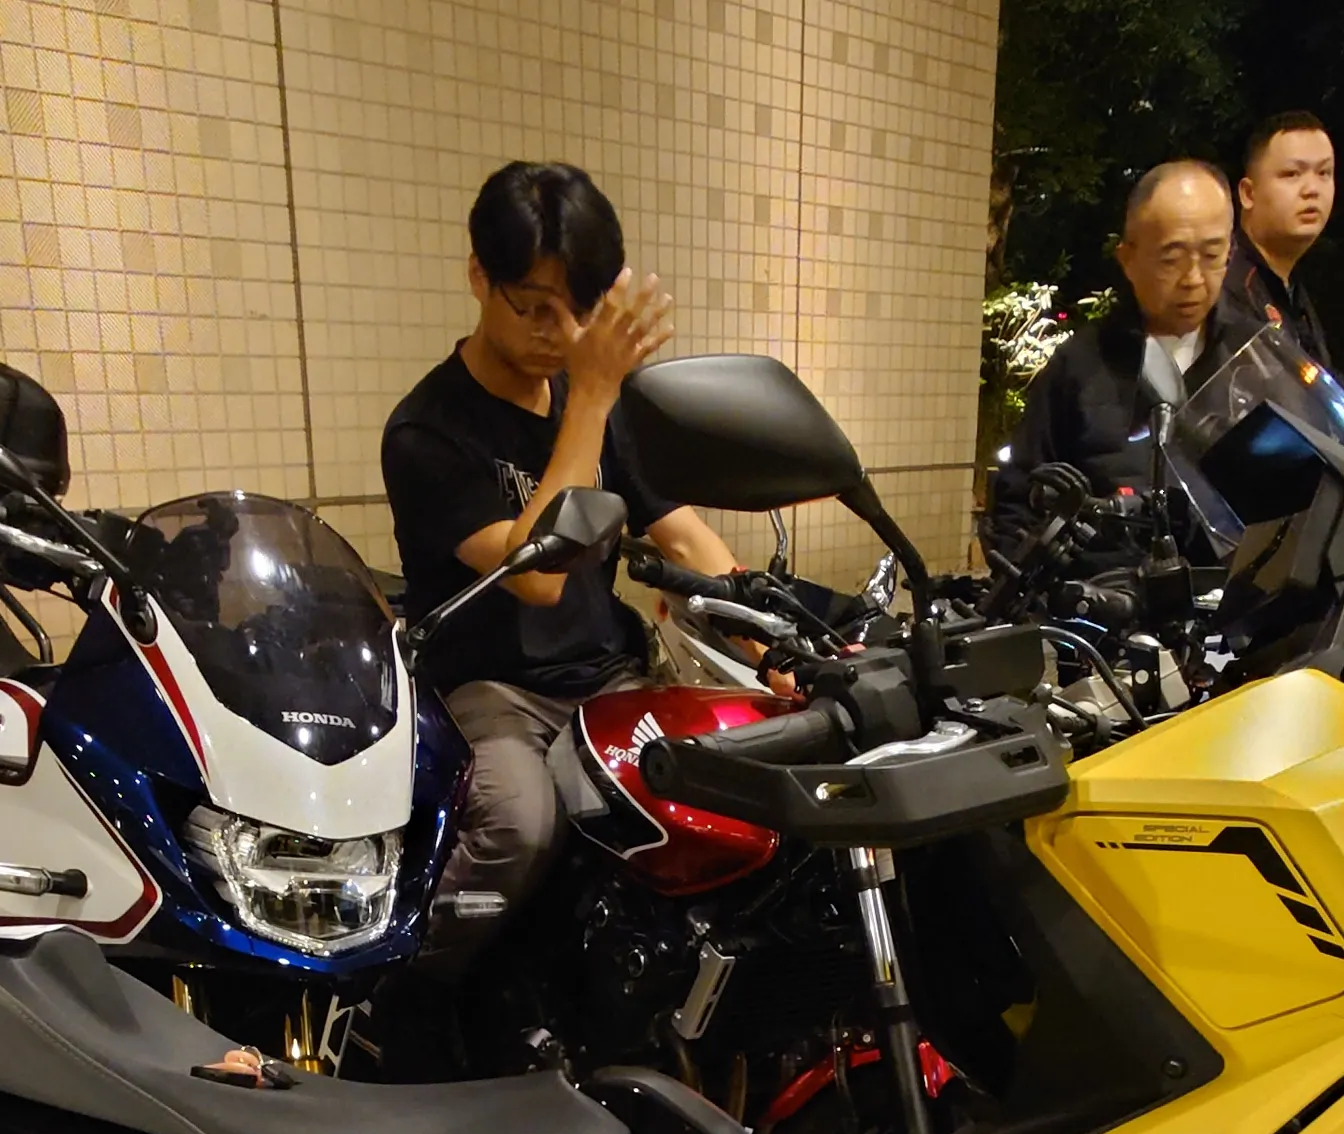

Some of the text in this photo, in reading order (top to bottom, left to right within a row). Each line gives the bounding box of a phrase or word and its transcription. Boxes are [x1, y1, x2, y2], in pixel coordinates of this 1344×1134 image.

[281, 711, 356, 729] HONDA
[1142, 824, 1211, 833] SPECIAL
[1133, 834, 1193, 842] EDITION
